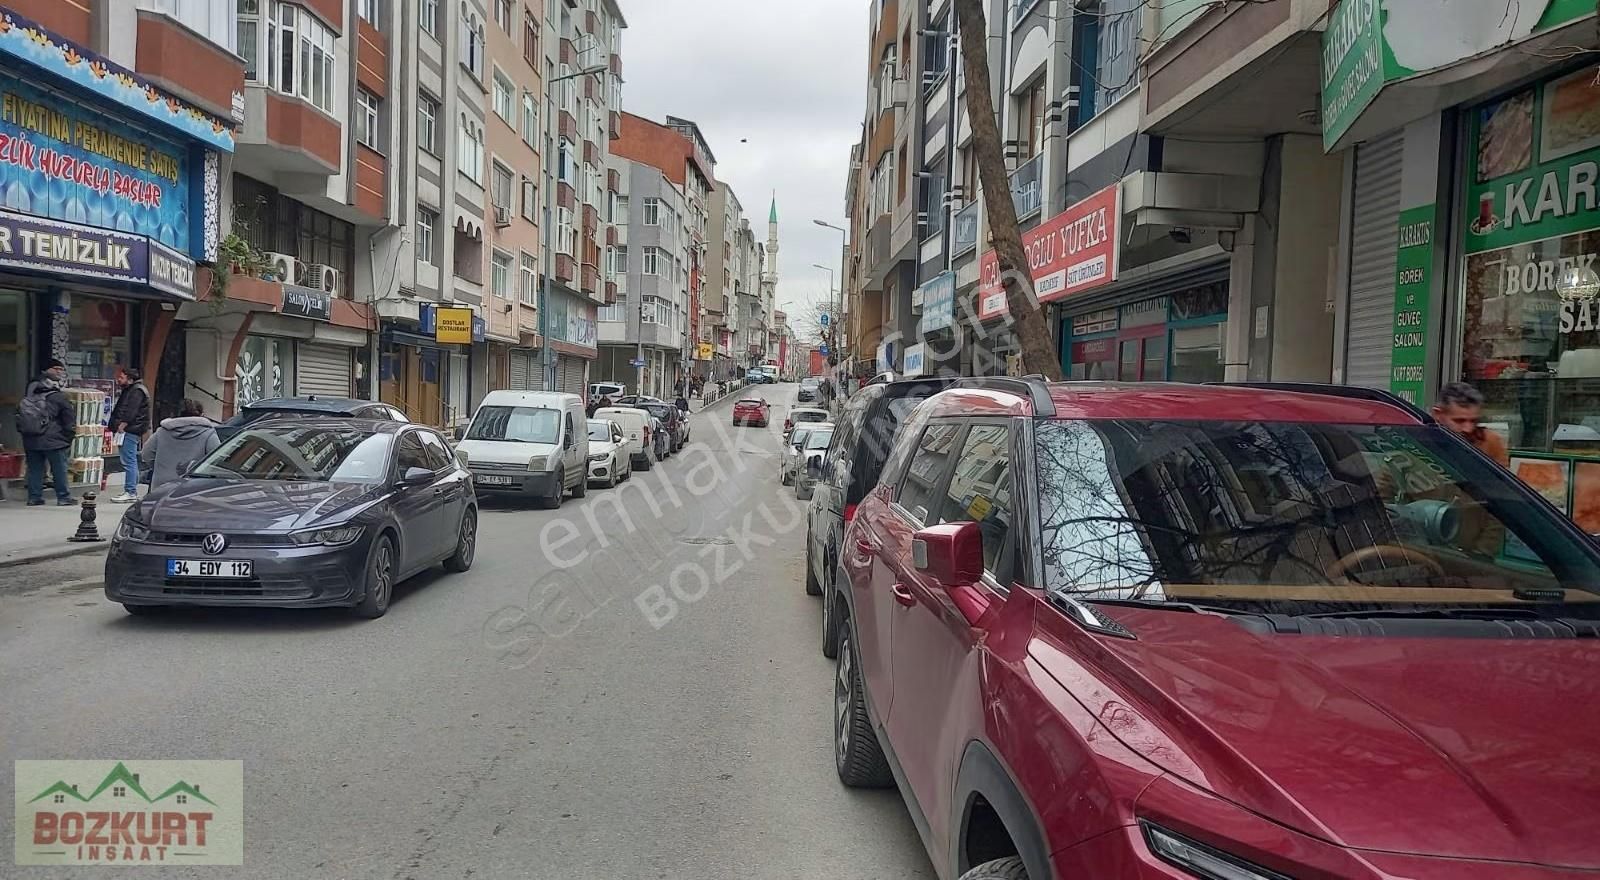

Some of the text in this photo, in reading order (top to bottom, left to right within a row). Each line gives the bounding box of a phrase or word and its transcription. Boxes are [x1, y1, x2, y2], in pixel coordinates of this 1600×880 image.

[74, 121, 147, 170] PERAKENDE
[150, 149, 178, 187] SATIŞ
[39, 148, 109, 192] HUZURLA
[1060, 207, 1108, 258] YUFKA
[19, 230, 131, 270] TEMİZLİK
[1399, 267, 1424, 285] BÖREK
[1406, 294, 1414, 305] ve
[1397, 310, 1421, 329] GÜVEÇ
[1559, 299, 1600, 333] SA
[1394, 332, 1424, 347] SALONU
[175, 562, 250, 576] 34 EDY 112
